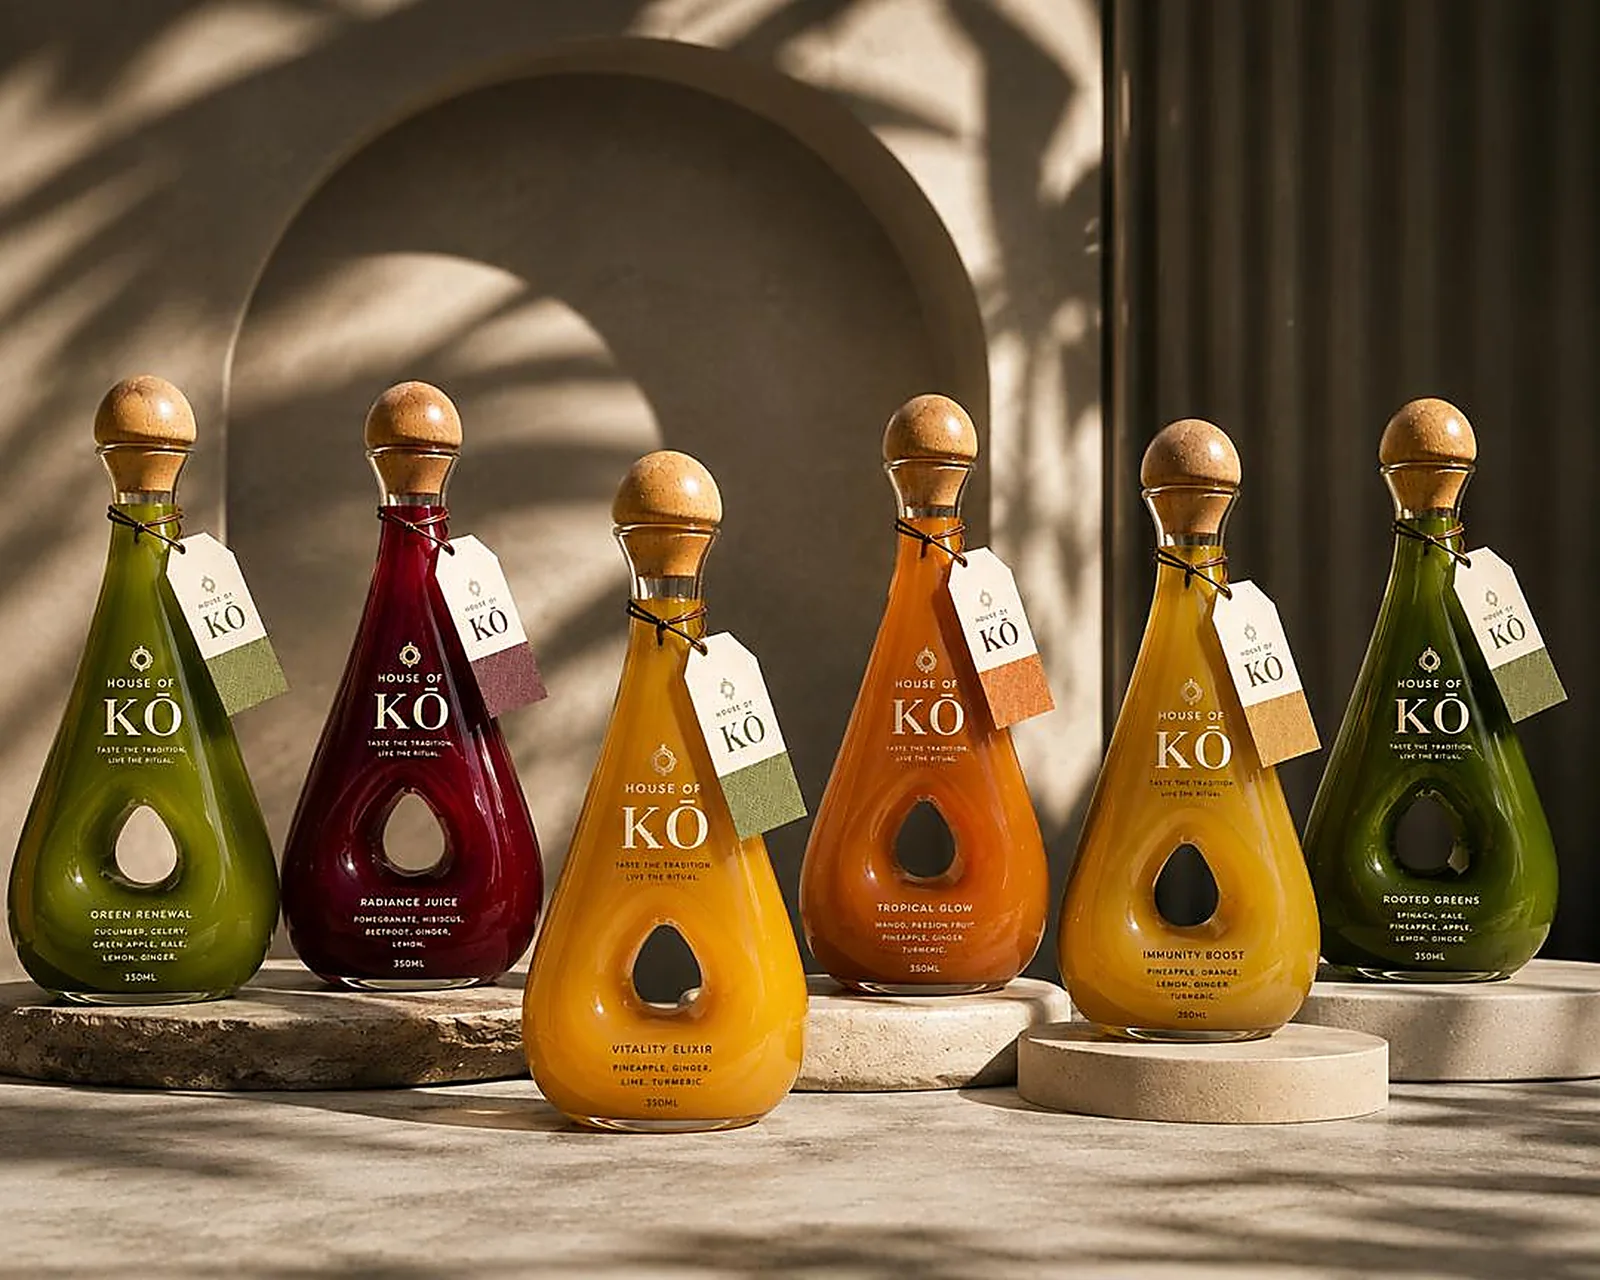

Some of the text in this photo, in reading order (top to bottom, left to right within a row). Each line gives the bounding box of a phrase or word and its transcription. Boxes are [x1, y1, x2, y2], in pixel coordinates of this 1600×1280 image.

[203, 601, 245, 638] KŌ
[469, 606, 508, 642] KŌ
[980, 618, 1018, 652] KŌ
[1488, 614, 1525, 649] KŌ
[1244, 652, 1283, 687] KŌ
[107, 678, 174, 688] HOUSE OF
[378, 673, 443, 683] HOUSE OF
[896, 680, 958, 689] HOUSE OF
[1398, 680, 1462, 689] HOUSE OF
[374, 687, 448, 730] KŌ
[1395, 692, 1470, 734] KŌ
[103, 692, 182, 736] KŌ
[892, 693, 964, 736] KŌ
[1158, 711, 1224, 720] HOUSE OF
[720, 711, 764, 753] KŌ
[124, 746, 138, 754] THE
[1155, 725, 1232, 770] KŌ
[626, 783, 700, 794] HOUSE OF
[622, 800, 708, 849] KŌ
[360, 898, 458, 907] RADIANCE JUICE
[1383, 895, 1480, 905] ROOTED GREENS
[877, 903, 973, 913] TROPICAL GLOW
[90, 910, 192, 919] GREEN RENEWAL
[92, 941, 123, 949] GREEN
[1143, 950, 1244, 959] IMMUNITY BOOST
[1414, 952, 1446, 961] 350ML
[394, 960, 424, 968] 350ML
[910, 964, 940, 973] 350ML
[124, 973, 158, 981] 350ML
[612, 1045, 712, 1054] VITALITY ELIXIR
[646, 1099, 678, 1108] 350ML
